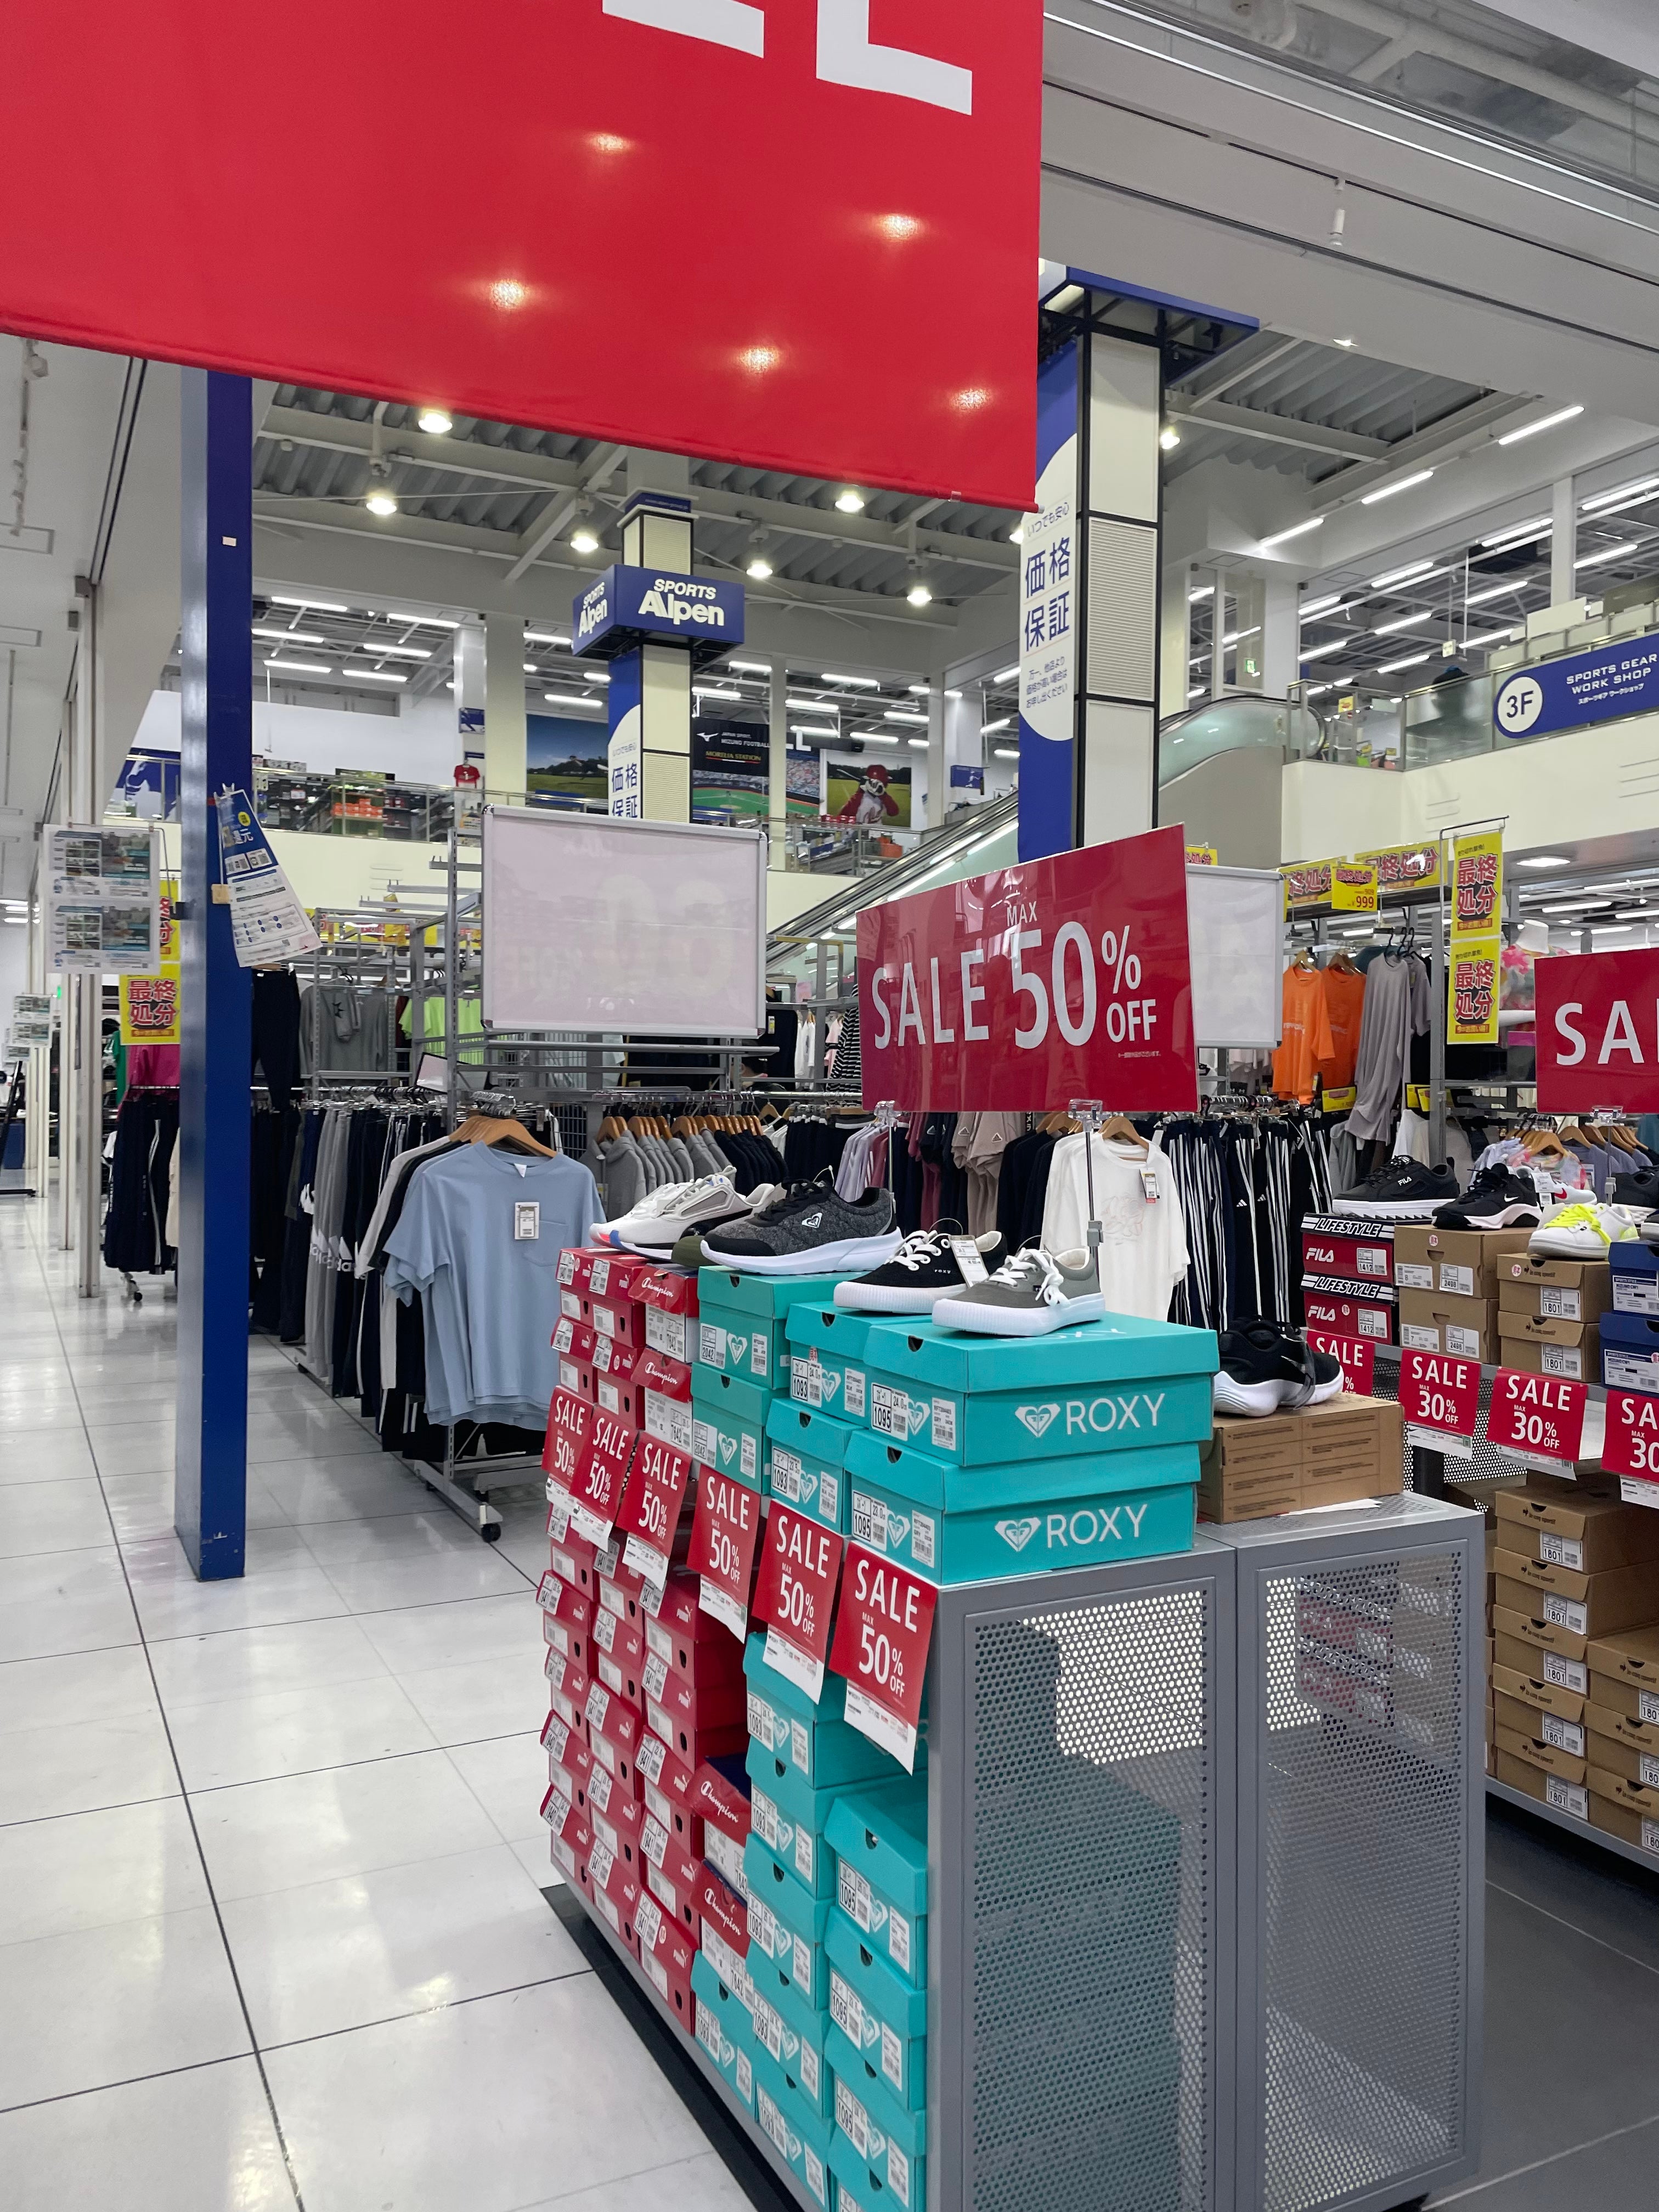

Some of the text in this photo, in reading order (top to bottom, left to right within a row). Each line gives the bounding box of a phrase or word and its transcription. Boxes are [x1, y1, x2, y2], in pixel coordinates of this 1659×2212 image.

[1026, 537, 1070, 599] 価格
[583, 582, 605, 609] SPORTS
[653, 579, 716, 600] SPORTS
[578, 599, 607, 637] Alpen
[638, 590, 725, 626] Alpen
[1025, 590, 1070, 652] 保証
[1566, 654, 1657, 685] SPORTS GEAR
[1571, 667, 1651, 695] WORK SHOP
[1507, 691, 1533, 718] 3F
[1006, 901, 1037, 926] MAX
[872, 947, 989, 1049] SALE
[1107, 999, 1156, 1043] OFF
[1555, 998, 1659, 1065] SA
[1314, 1217, 1382, 1238] LIFESTYLE
[1306, 1247, 1334, 1262] FILA
[641, 1277, 674, 1297] Champion
[1314, 1276, 1380, 1299] LIFESTYLE
[1308, 1305, 1336, 1322] FILA
[1544, 1303, 1561, 1314] 1801
[1316, 1338, 1363, 1367] SALE
[1547, 1358, 1562, 1370] 1801
[645, 1362, 678, 1385] Champion
[1412, 1356, 1468, 1389] SALE
[794, 1378, 808, 1398] 1093
[1506, 1375, 1572, 1412] SALE
[555, 1396, 585, 1435] SALE
[874, 1406, 891, 1429] 1095
[1066, 1393, 1166, 1435] ROXY
[1445, 1414, 1459, 1425] OFF
[1621, 1398, 1658, 1430] SA
[592, 1417, 629, 1461] SALE
[1544, 1437, 1560, 1449] OFF
[1631, 1430, 1645, 1438] MAX
[642, 1443, 681, 1491] SALE
[774, 1468, 786, 1489] 1093
[600, 1492, 610, 1505] OFF
[706, 1476, 750, 1531] SALE
[658, 1525, 667, 1539] OFF
[855, 1514, 870, 1538] 1095
[1046, 1504, 1148, 1549] ROXY
[776, 1515, 830, 1579] SALE
[1544, 1548, 1561, 1561] 1801
[730, 1567, 741, 1584] OFF
[782, 1562, 792, 1575] MAX
[855, 1559, 920, 1633] SALE
[802, 1617, 815, 1637] OFF
[862, 1611, 874, 1626] MAX
[1548, 1609, 1565, 1624] 1801
[890, 1675, 905, 1698] OFF
[1548, 1668, 1565, 1683] 1801
[1545, 1730, 1562, 1744] 1801
[701, 1781, 738, 1823] Champion
[1549, 1791, 1566, 1806] 1801
[841, 1884, 855, 1912] 1095
[704, 1888, 741, 1936] Champion
[749, 1913, 762, 1939] 1093
[833, 1997, 847, 2025] 1095
[754, 2012, 768, 2040] 1093
[838, 2102, 853, 2134] 1095
